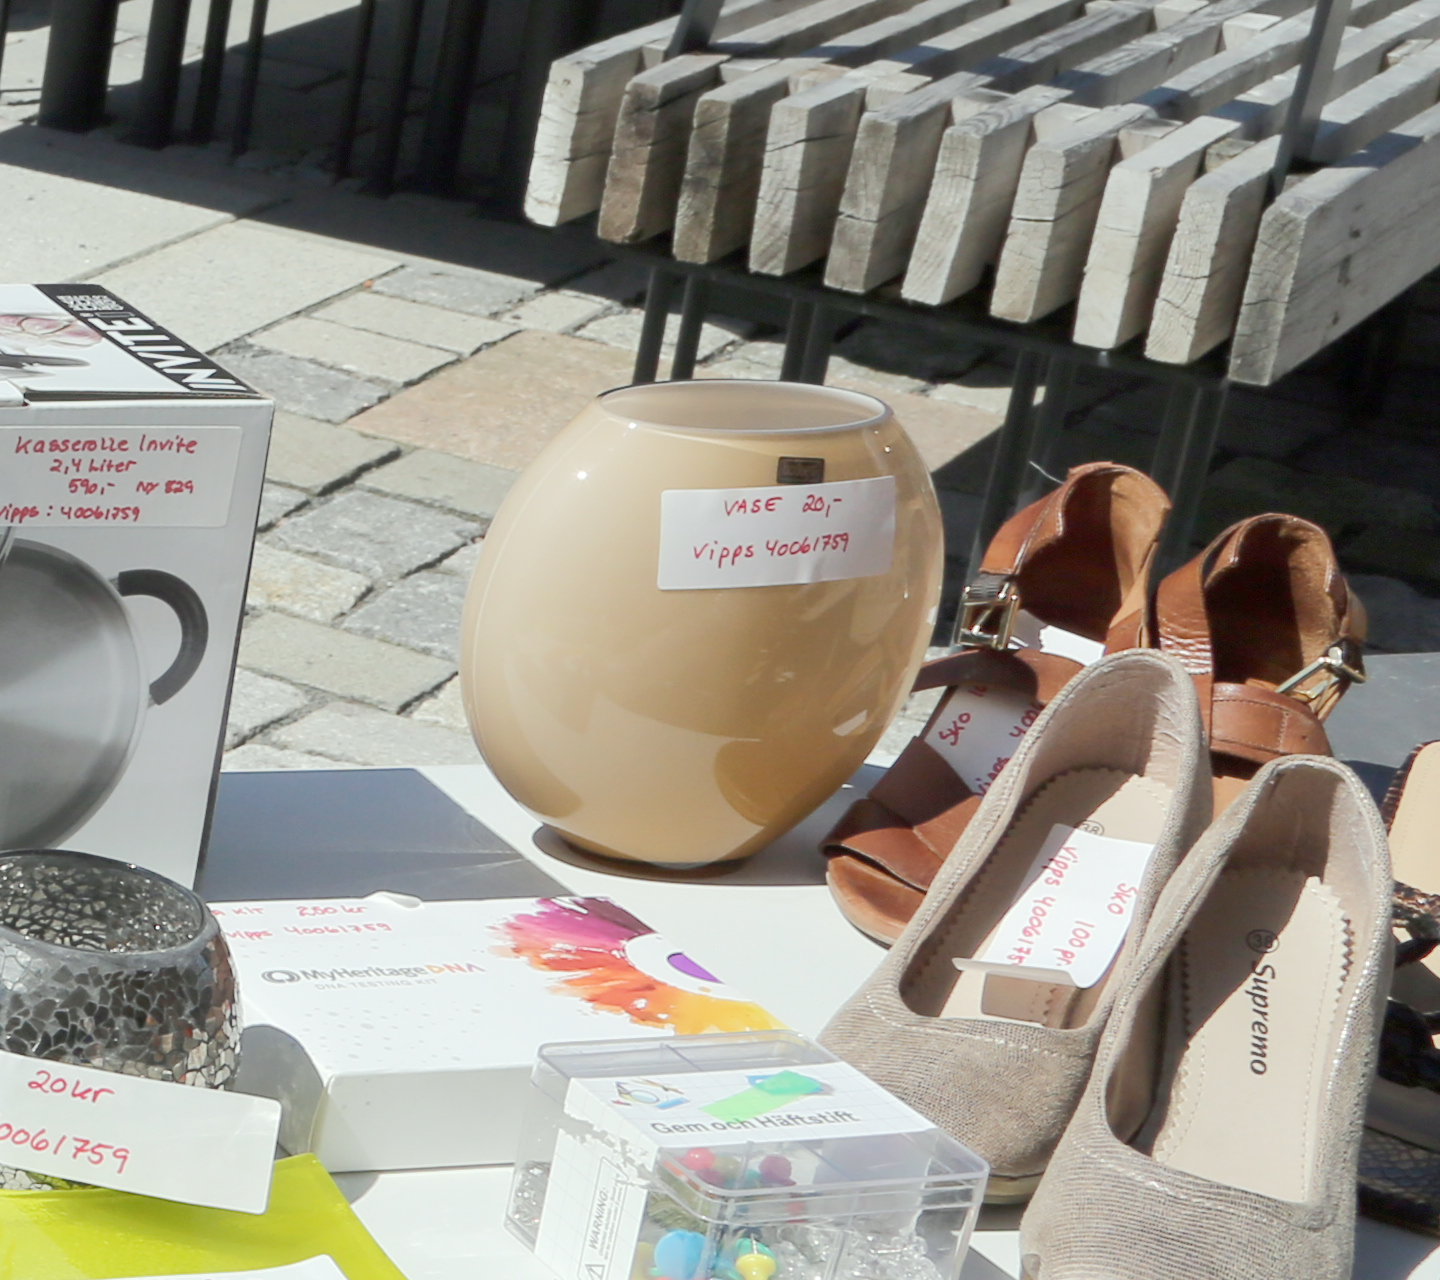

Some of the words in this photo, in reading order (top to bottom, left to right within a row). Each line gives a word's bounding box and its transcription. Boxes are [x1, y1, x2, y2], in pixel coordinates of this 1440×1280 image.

[87, 317, 248, 391] INVITE
[61, 505, 142, 523] 40061759
[724, 496, 783, 517] VASE
[765, 532, 849, 558] 40061759
[283, 923, 394, 936] 40061759
[315, 982, 349, 991] DNA
[350, 979, 413, 989] TESTING
[414, 978, 440, 986] KIT
[1244, 960, 1276, 1077] Supremo
[651, 1121, 710, 1135] Gem
[709, 1118, 757, 1132] och
[759, 1110, 861, 1128] Häftstift
